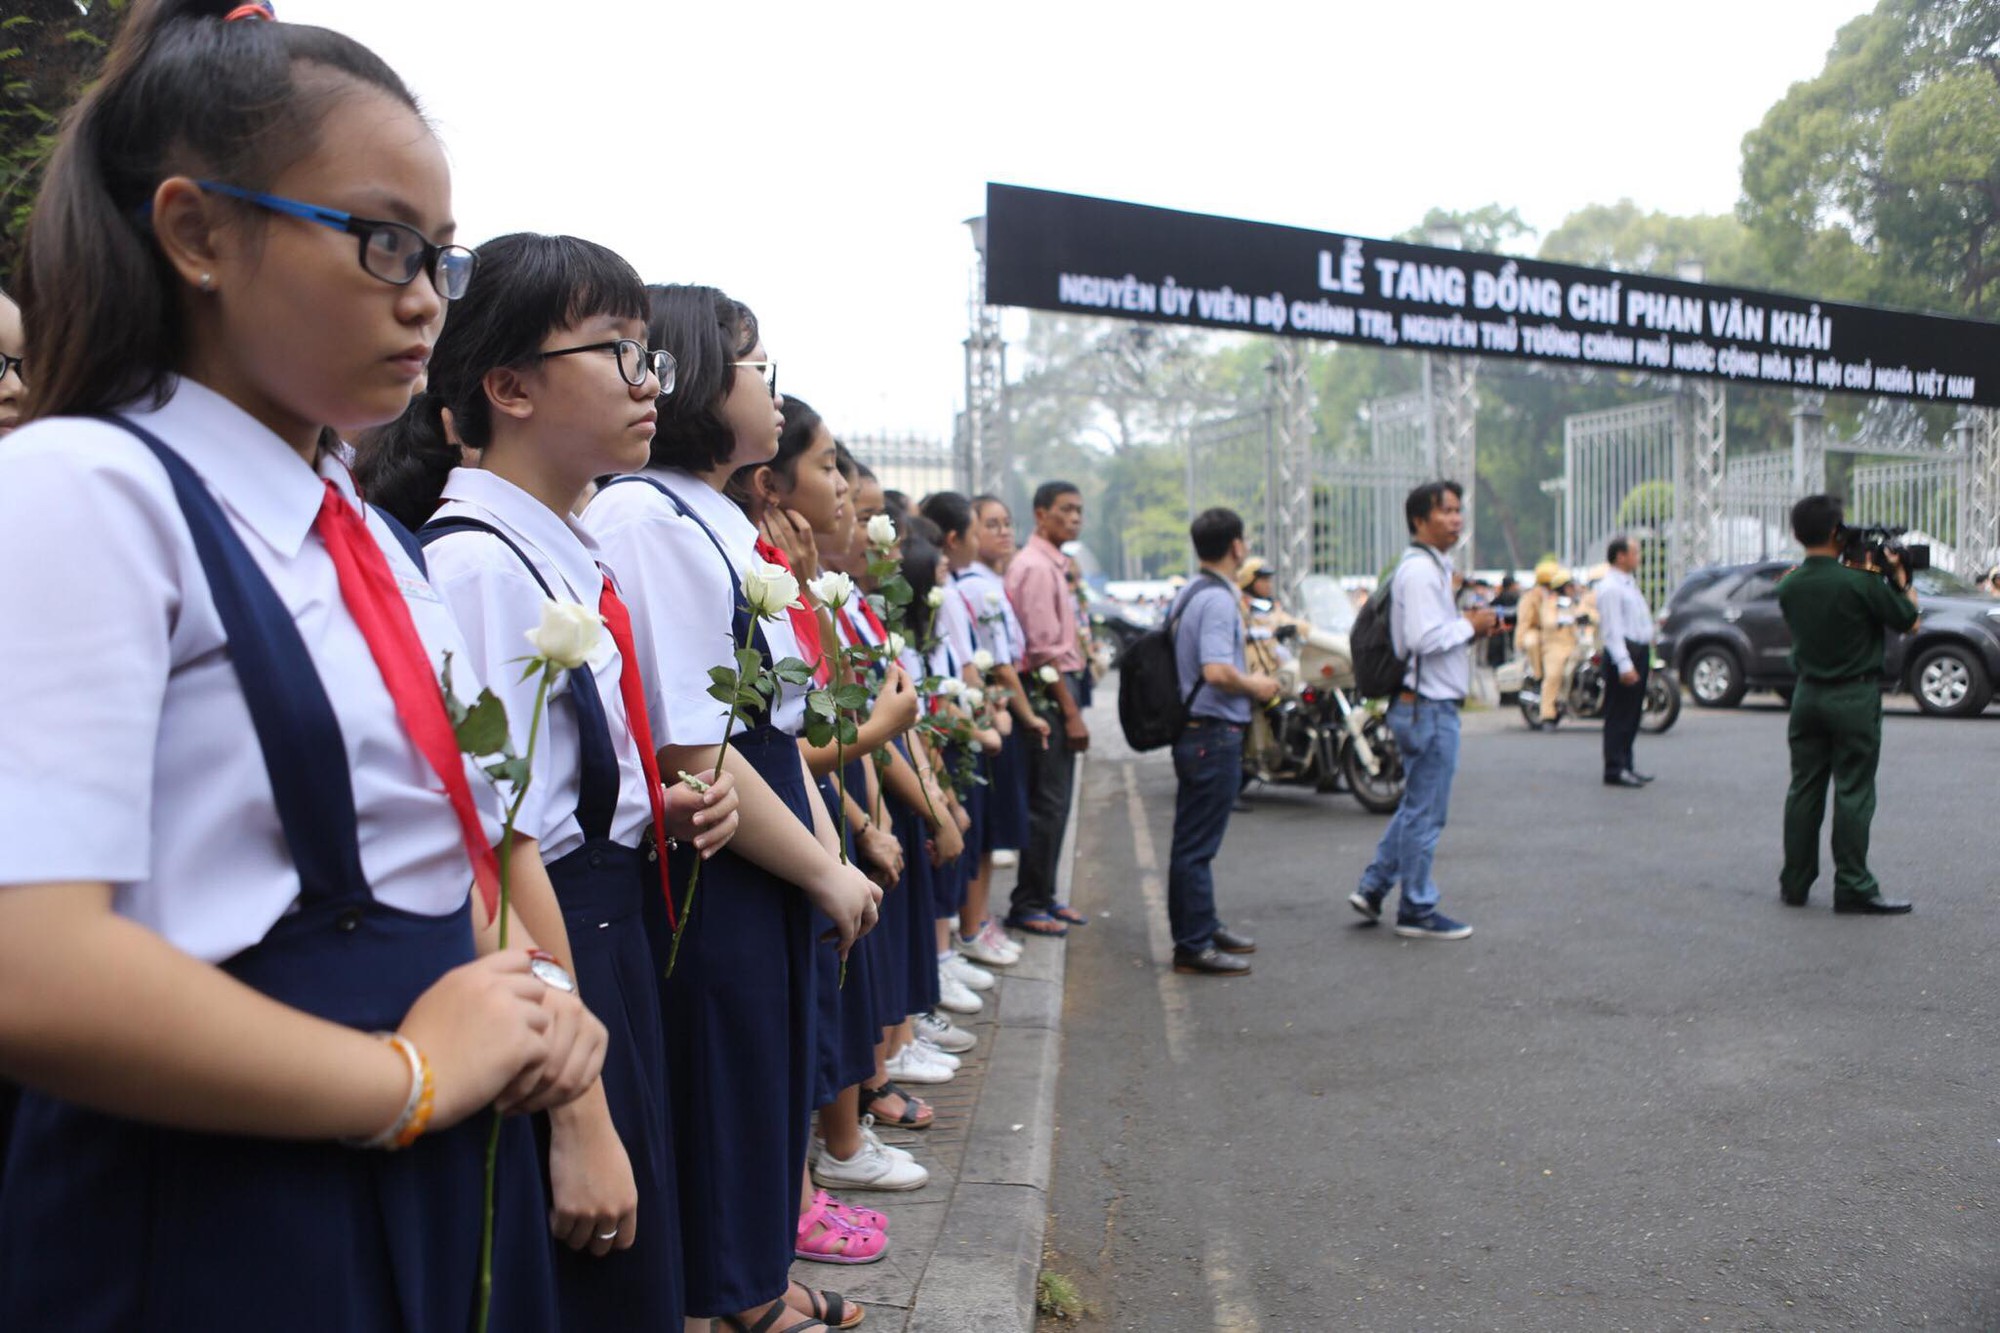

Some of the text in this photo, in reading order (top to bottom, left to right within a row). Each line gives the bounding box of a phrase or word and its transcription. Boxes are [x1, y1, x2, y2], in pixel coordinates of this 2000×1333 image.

[1059, 272, 1156, 313] NGUYÊN
[1160, 275, 1193, 316] ỦY
[1196, 285, 1250, 324] VIÊN
[1254, 291, 1287, 332] BỘ
[1290, 298, 1355, 335] CHÍNH
[1401, 312, 1478, 348] NGUYÊN
[1480, 315, 1518, 352] THỦ
[1582, 330, 1634, 364] CHÍNH
[1717, 343, 1759, 379] CỘNG
[1916, 367, 1945, 399] VIỆT
[1946, 374, 1975, 399] NAM
[1318, 237, 1832, 350] LỄ TANG ĐỒNG CHÍ PHAN VĂN KHẢI
